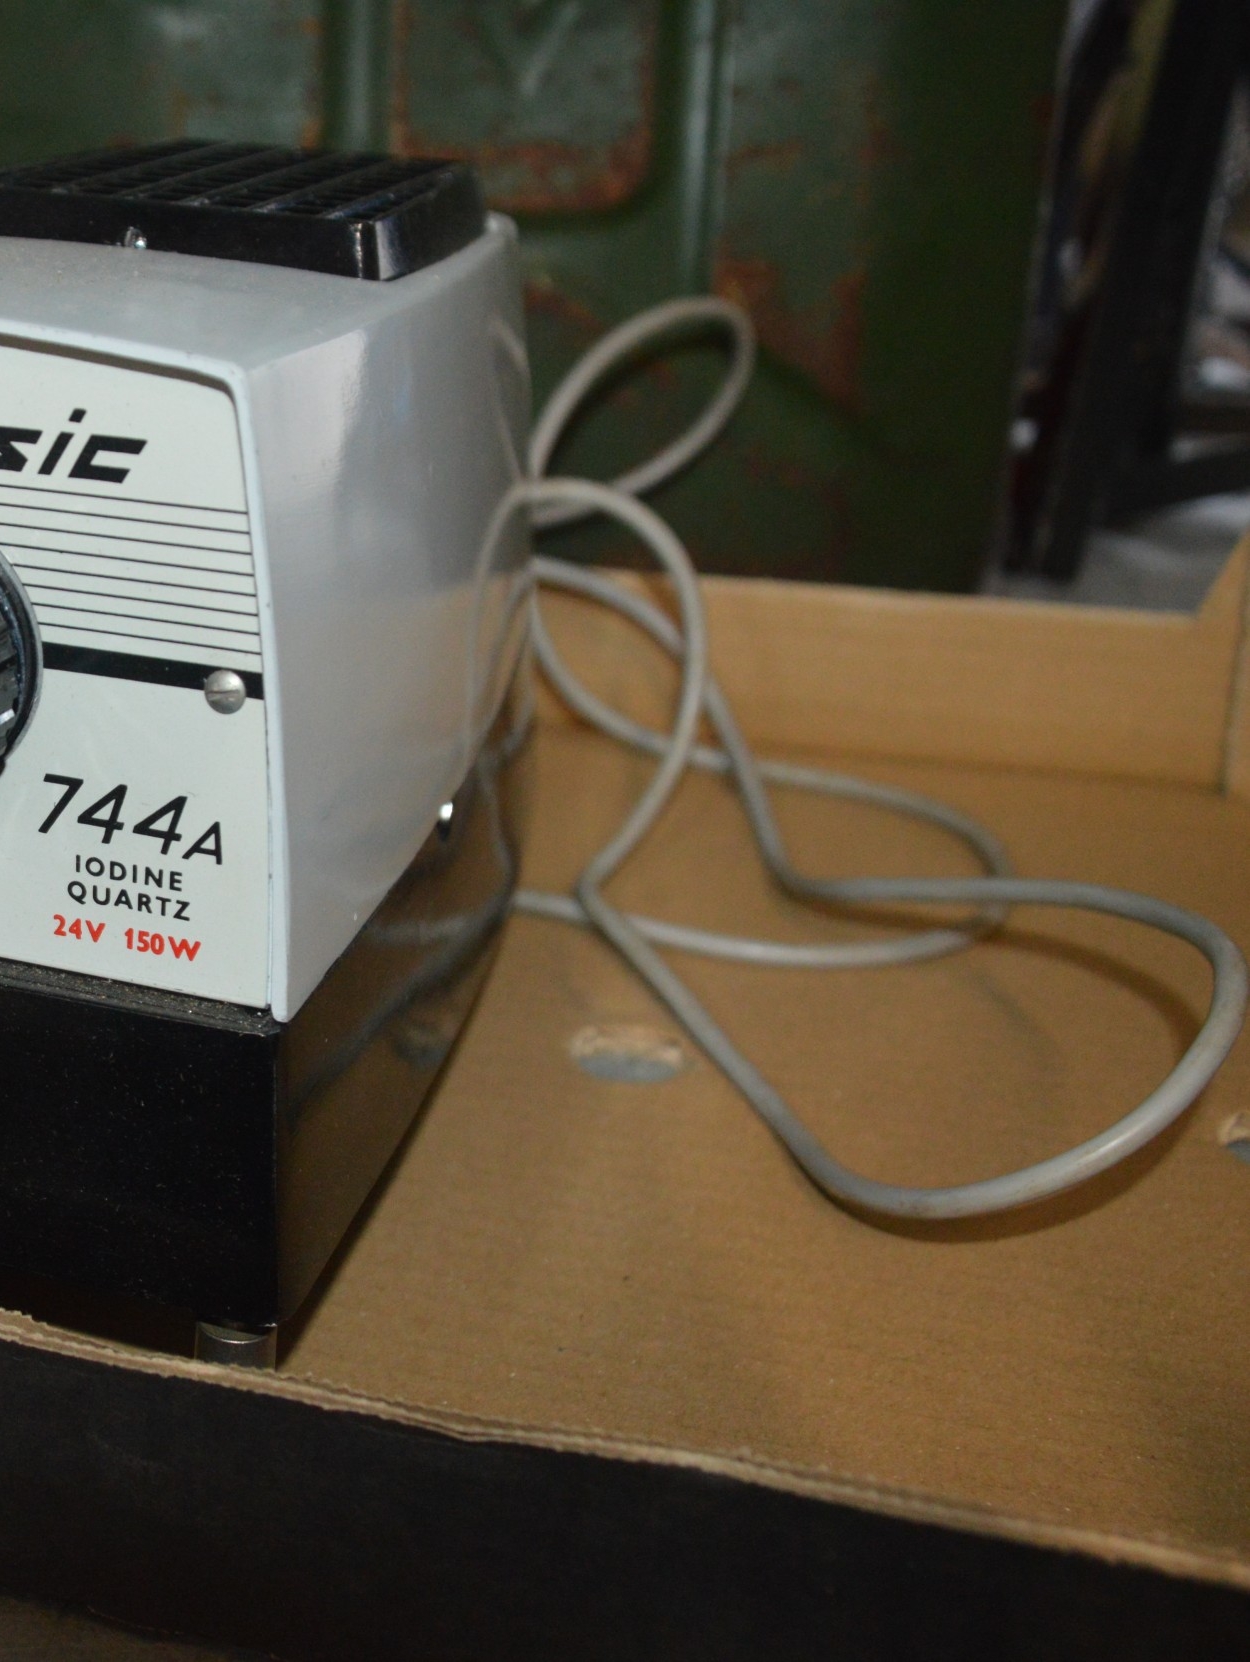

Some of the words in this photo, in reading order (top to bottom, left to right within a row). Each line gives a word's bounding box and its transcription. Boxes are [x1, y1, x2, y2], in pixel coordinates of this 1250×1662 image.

[38, 773, 223, 866] 744A
[75, 854, 183, 893] IODINE
[67, 880, 191, 922] QUARTZ
[53, 914, 106, 943] 24V
[124, 927, 202, 962] 150W
